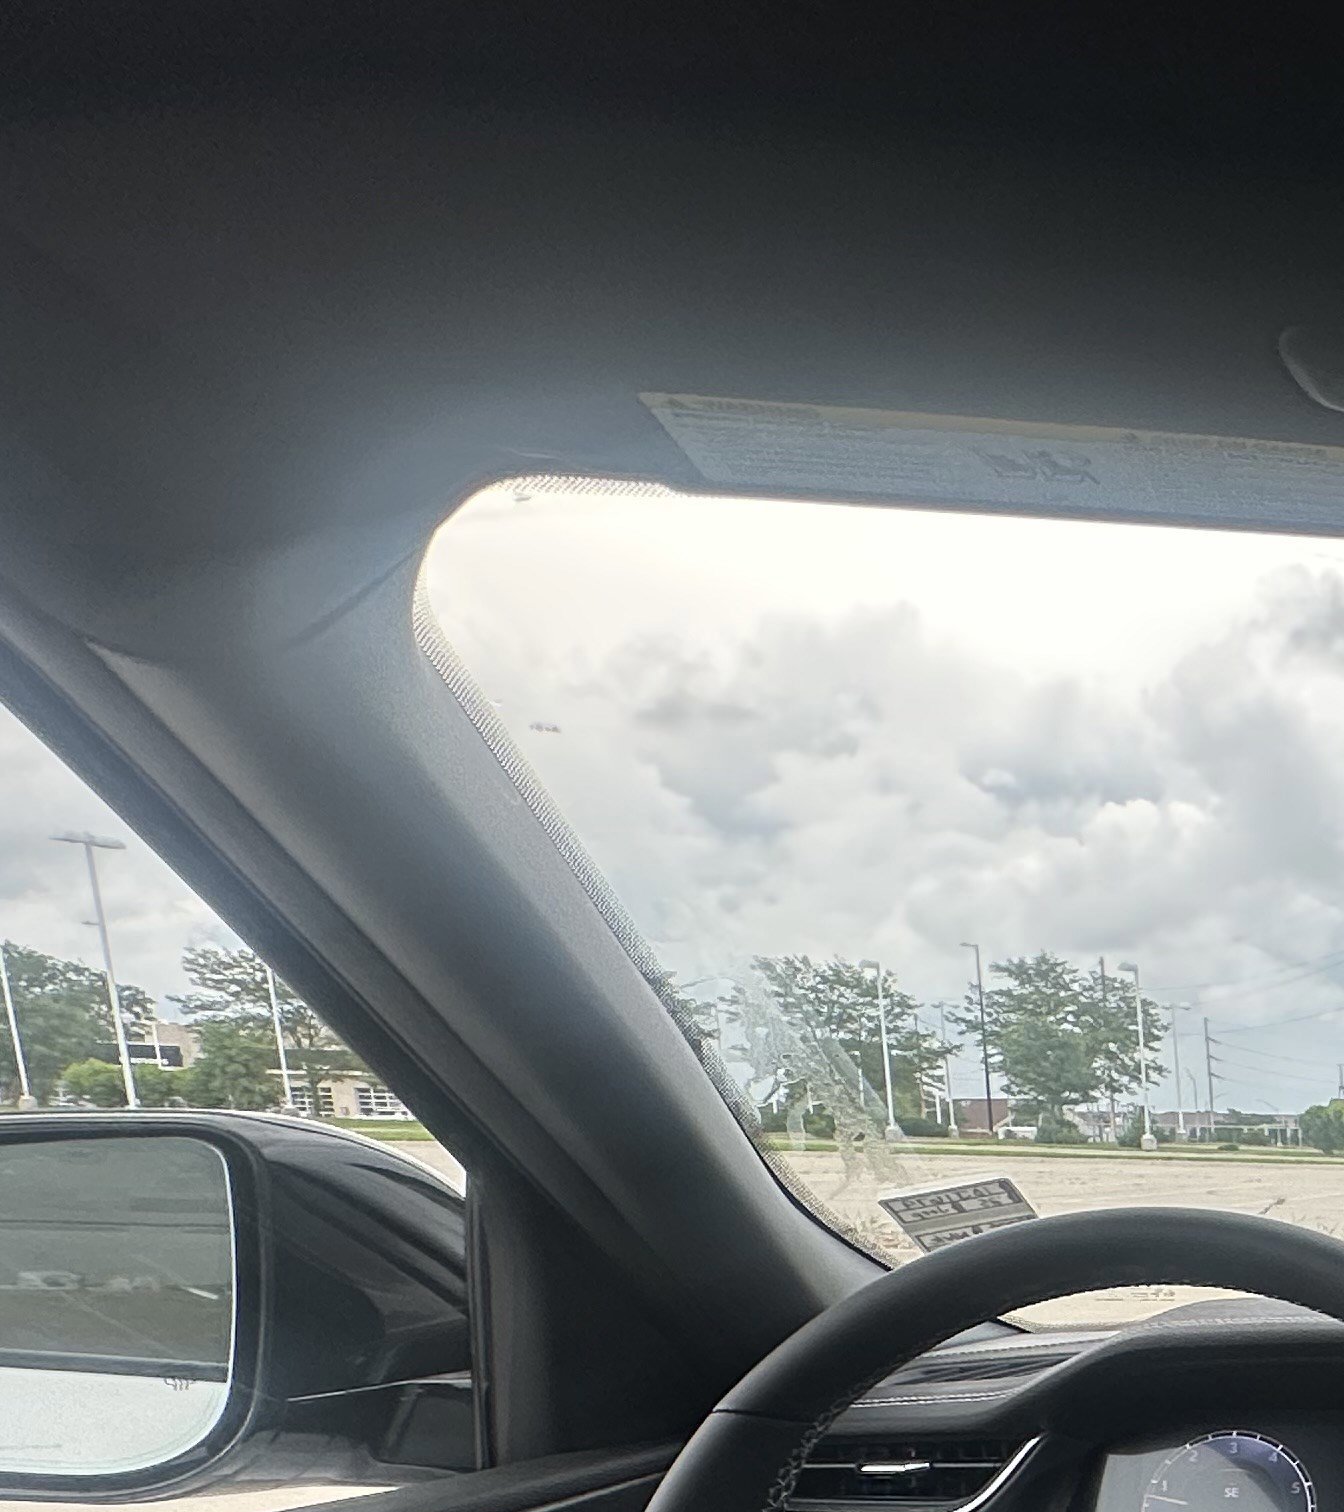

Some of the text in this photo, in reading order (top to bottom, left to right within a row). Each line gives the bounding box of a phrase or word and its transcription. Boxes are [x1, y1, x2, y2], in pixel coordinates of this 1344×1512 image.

[1229, 1442, 1239, 1454] 3
[1188, 1450, 1199, 1463] 2
[1267, 1452, 1278, 1463] 4
[1290, 1482, 1300, 1494] 5
